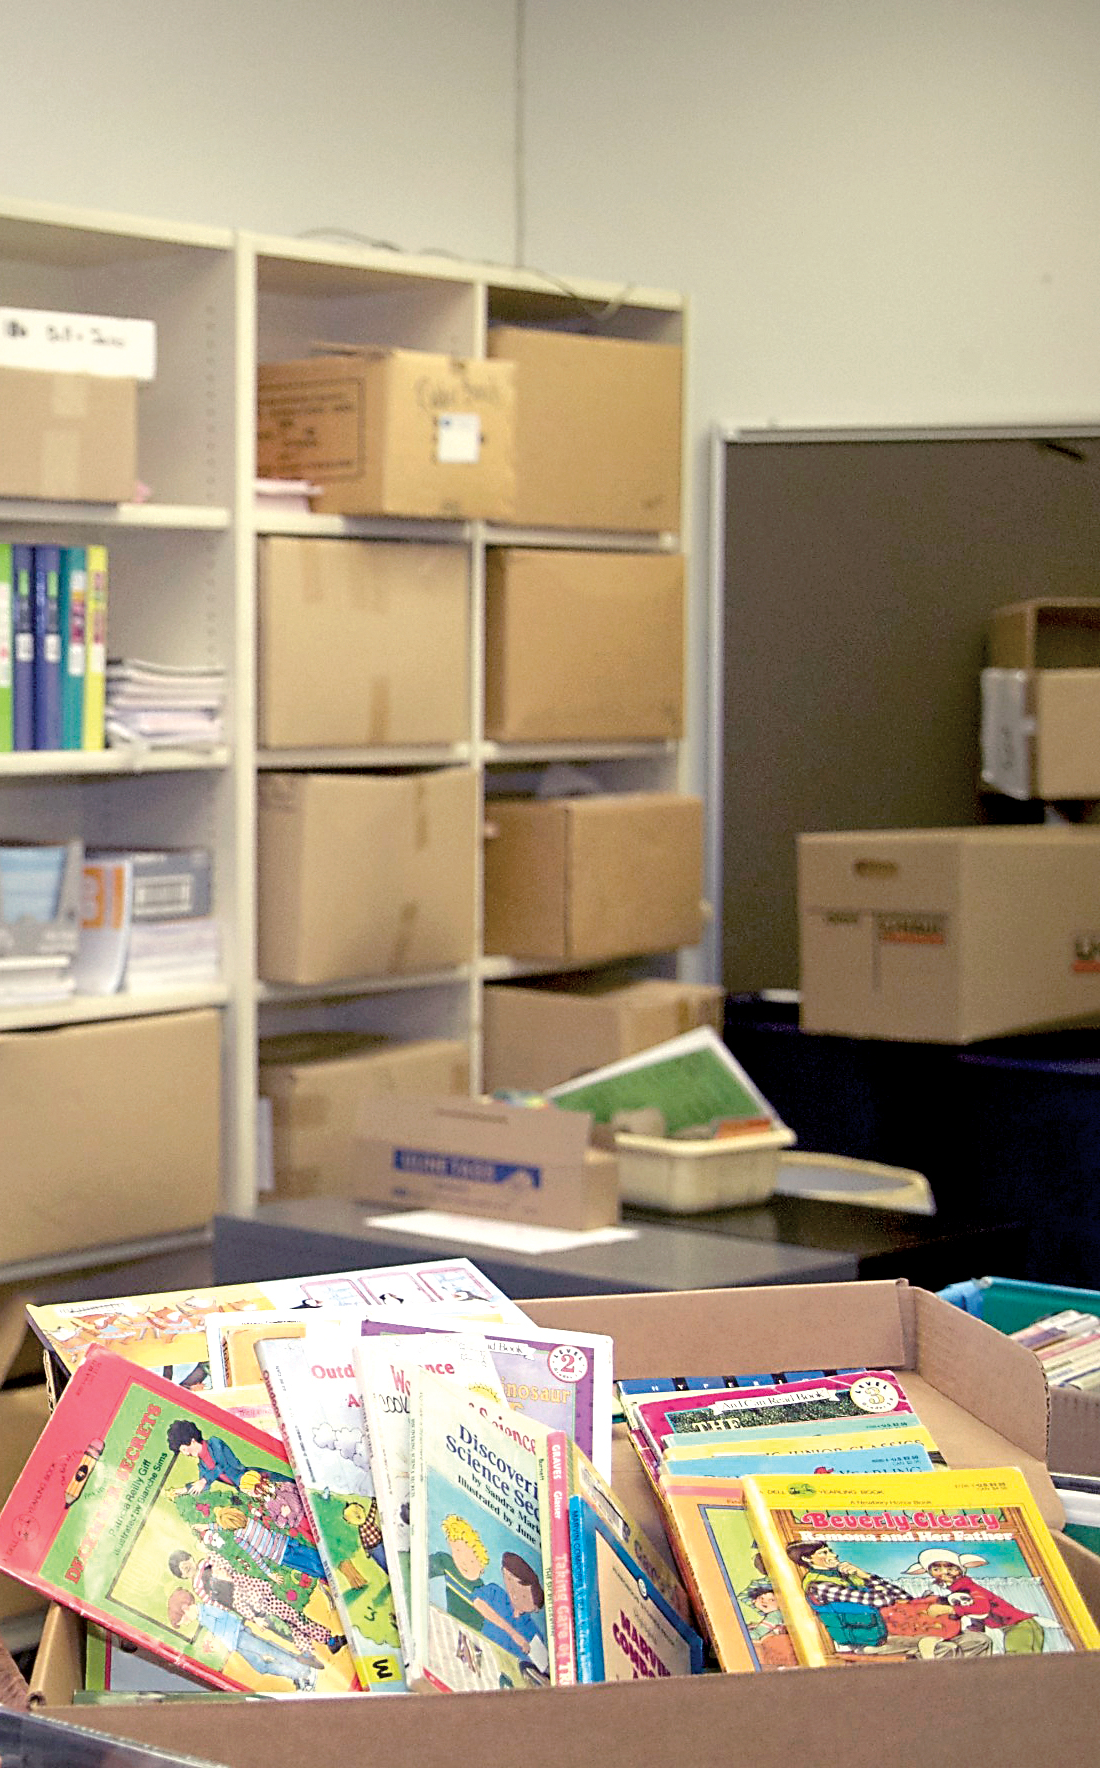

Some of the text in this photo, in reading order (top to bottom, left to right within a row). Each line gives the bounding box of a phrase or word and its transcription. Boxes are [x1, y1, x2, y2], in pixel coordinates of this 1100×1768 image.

[554, 1348, 583, 1361] LEVEL
[560, 1354, 575, 1373] 2
[311, 1364, 355, 1379] Outd
[262, 1369, 282, 1421] Outdoor
[501, 1376, 571, 1404] inosaur
[722, 1401, 738, 1412] An
[769, 1393, 794, 1407] Read
[796, 1389, 824, 1402] Book
[854, 1380, 888, 1394] LEVEL
[865, 1387, 885, 1405] 3
[691, 1417, 743, 1433] THE
[113, 1403, 163, 1482] SECRETS
[152, 1452, 168, 1472] Sims
[446, 1435, 510, 1496] Science
[459, 1424, 539, 1501] Discoveri
[551, 1444, 562, 1480] GRAVES
[124, 1476, 145, 1504] Reilly
[137, 1459, 151, 1476] Giff
[457, 1474, 537, 1545] Illustrated by June
[471, 1474, 540, 1536] by Sandra Mark
[800, 1511, 1001, 1533] Beverly Cleary
[799, 1531, 1014, 1541] Ramona and Her Father
[553, 1553, 567, 1601] Taking
[556, 1605, 568, 1640] Care
[558, 1661, 571, 1687] TR
